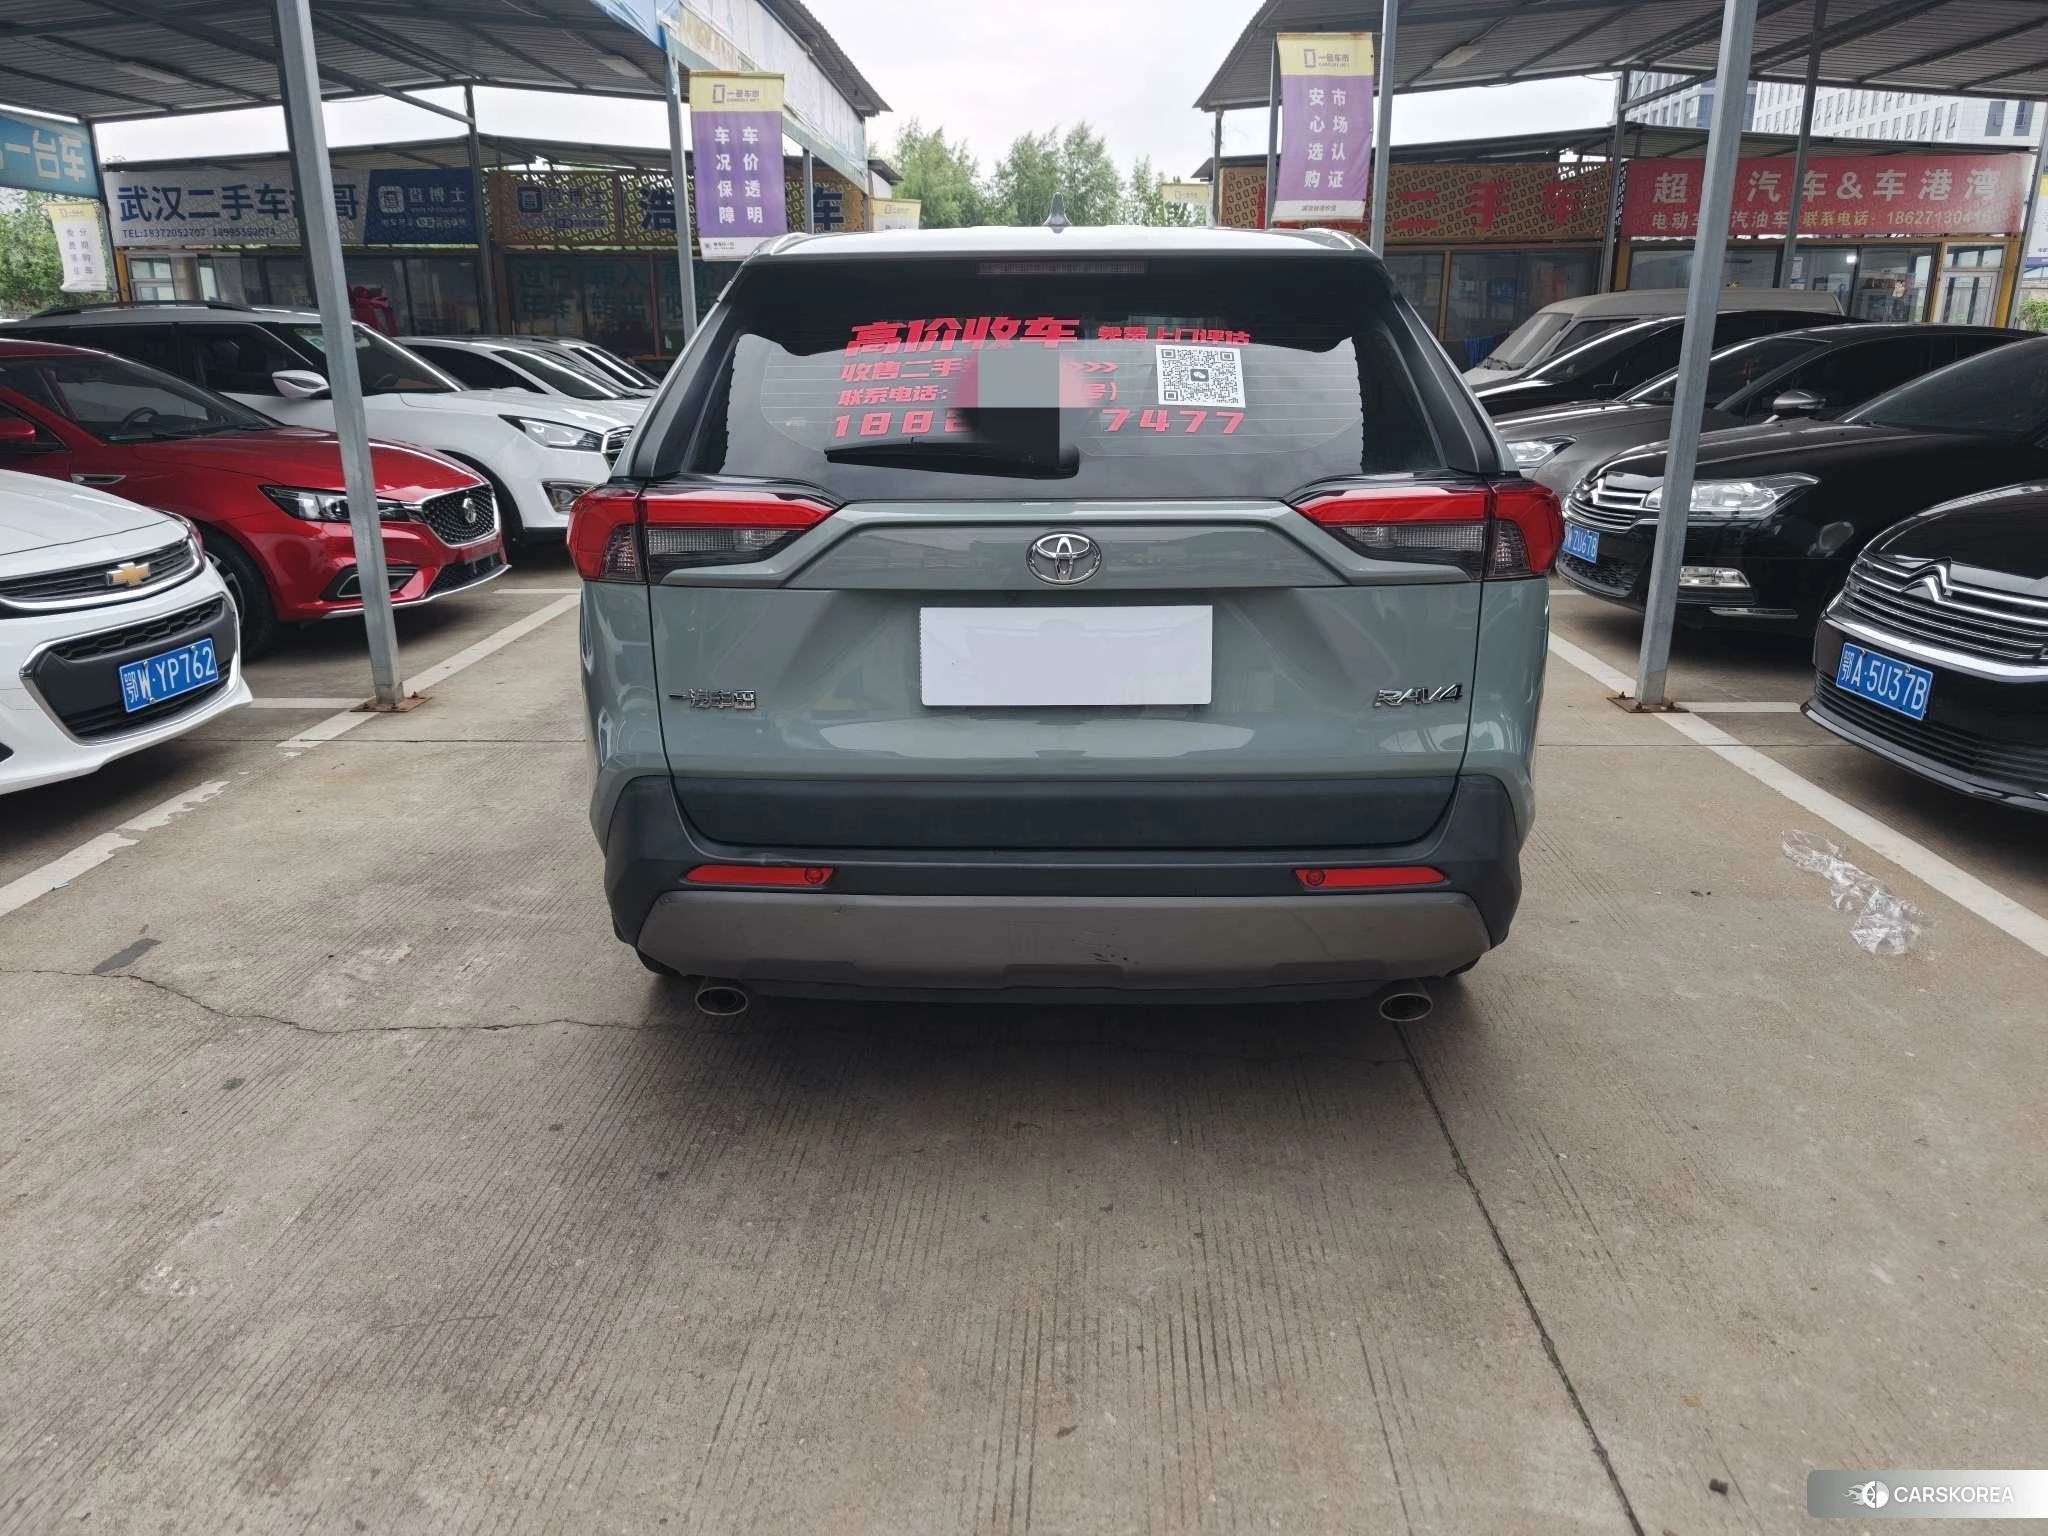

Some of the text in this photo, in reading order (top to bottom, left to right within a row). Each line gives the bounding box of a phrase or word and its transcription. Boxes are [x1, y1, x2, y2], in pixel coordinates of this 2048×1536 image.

[1304, 88, 1326, 188] 安心选购
[1327, 88, 1348, 188] 市场认证
[714, 126, 735, 223] 车况保障
[742, 126, 763, 223] 车价透明
[1653, 168, 2000, 203] 超汽车&车港湾
[117, 183, 358, 222] 武汉二手车哥
[844, 315, 1080, 357] 高价收车
[1101, 408, 1245, 434] 7477
[1373, 683, 1463, 708] RAV4
